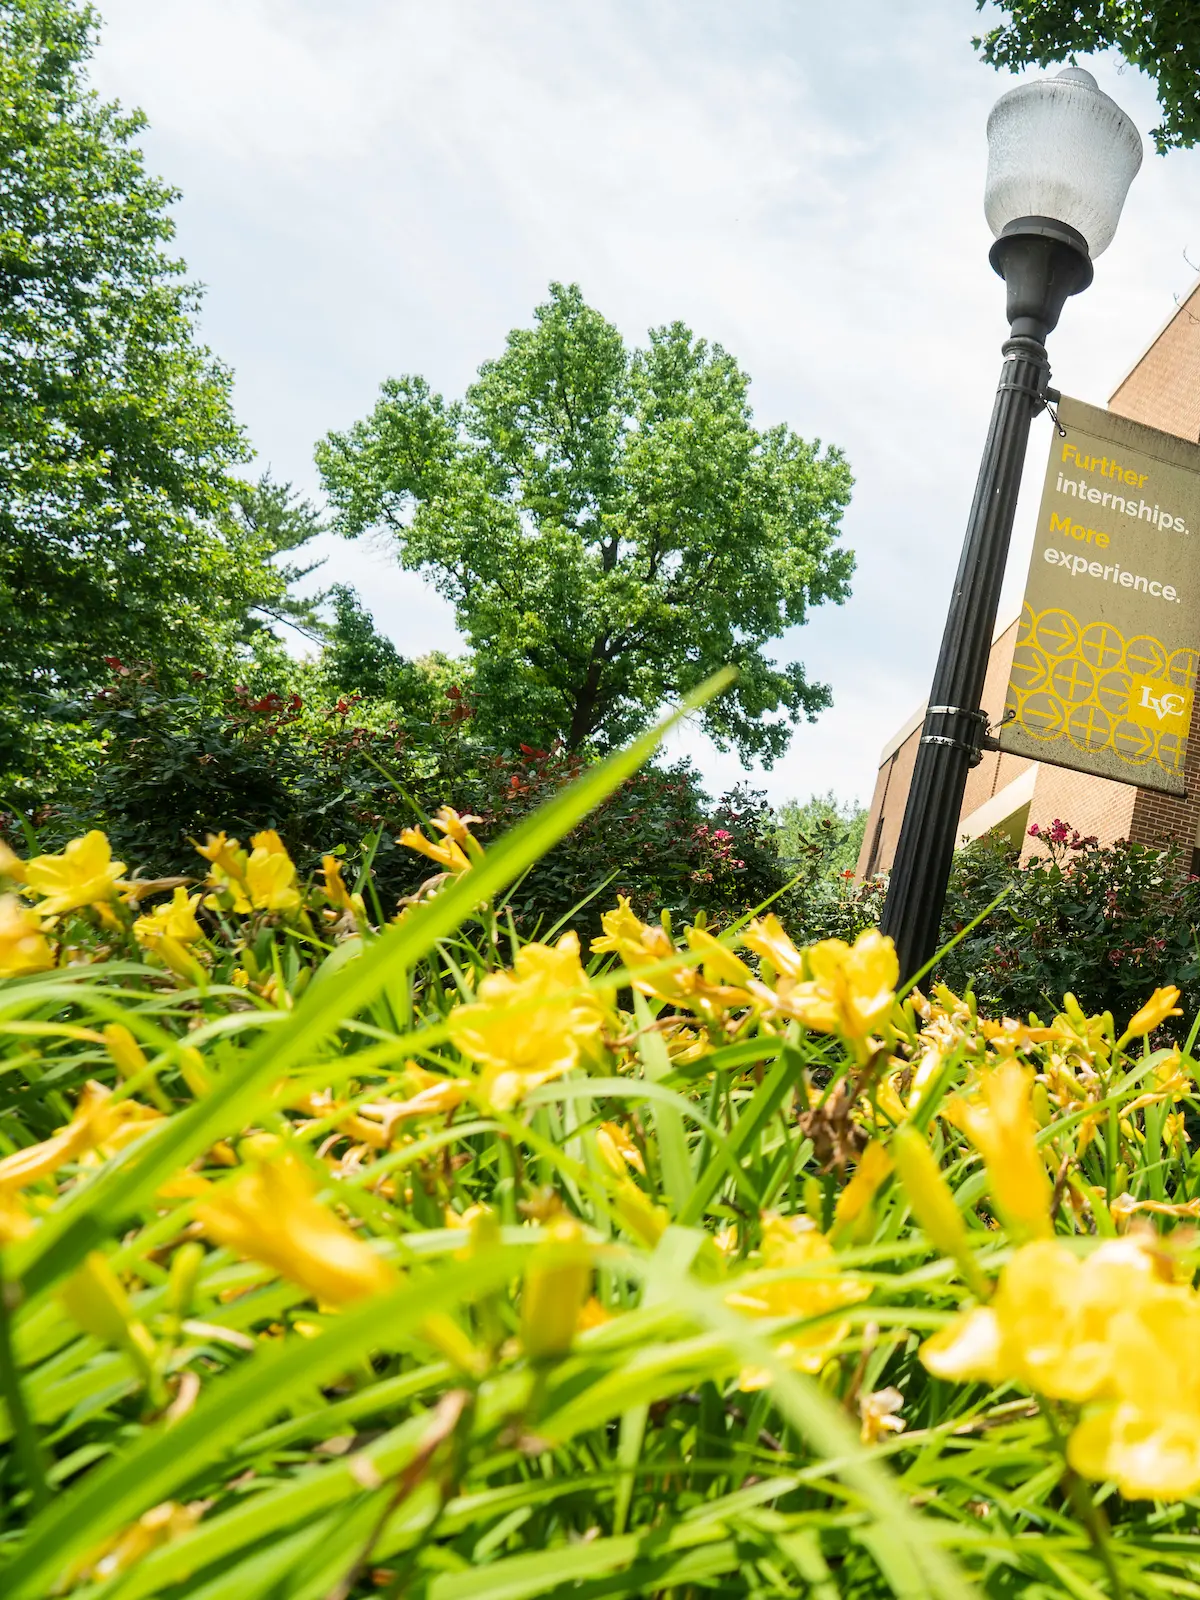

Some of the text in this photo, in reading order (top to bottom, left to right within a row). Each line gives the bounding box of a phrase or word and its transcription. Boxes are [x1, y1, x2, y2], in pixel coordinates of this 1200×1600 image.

[1061, 443, 1149, 488] Further
[1056, 472, 1190, 535] internships.
[1049, 512, 1110, 548] More
[1043, 548, 1181, 603] experience.
[1138, 685, 1185, 720] LVC
